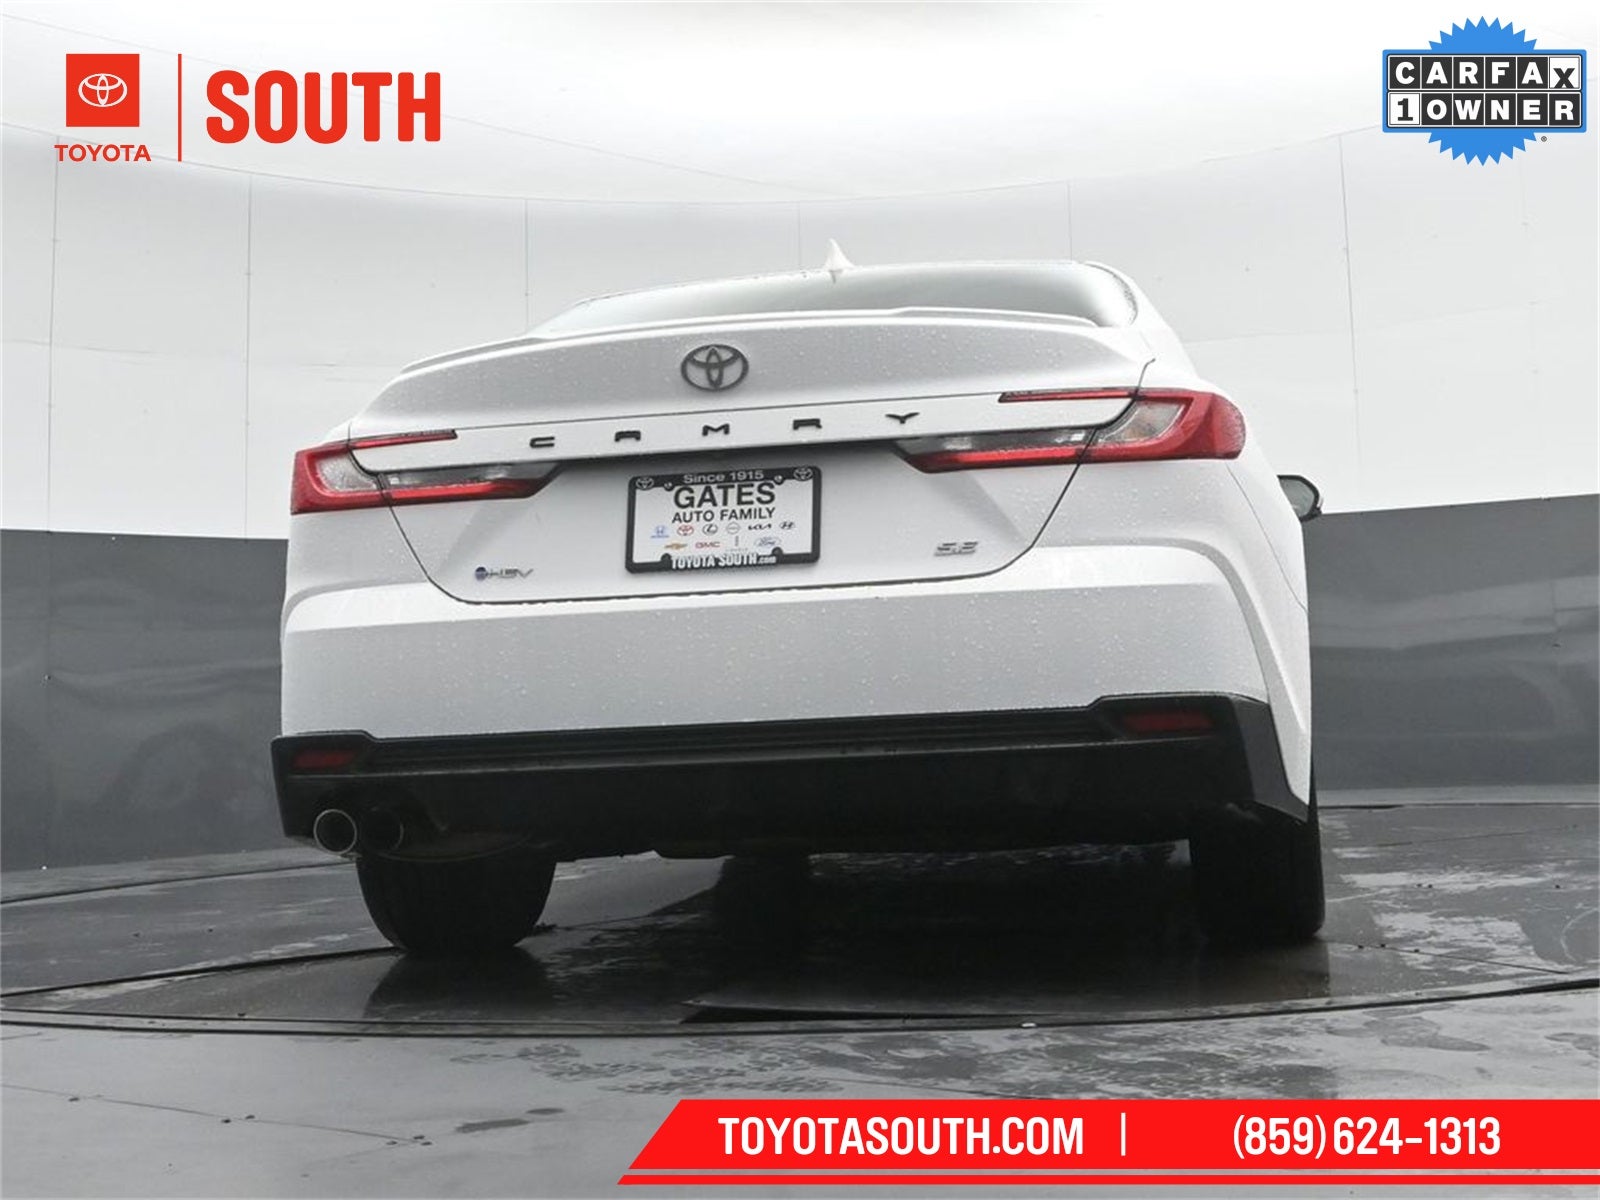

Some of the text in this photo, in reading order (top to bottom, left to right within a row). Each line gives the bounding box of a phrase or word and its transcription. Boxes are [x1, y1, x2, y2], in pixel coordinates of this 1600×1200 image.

[529, 412, 920, 449] CAMRY
[683, 470, 765, 484] Since 1915
[673, 482, 776, 509] GATES
[672, 507, 776, 523] AUTO FAMILY
[672, 555, 715, 570] TOYOTA
